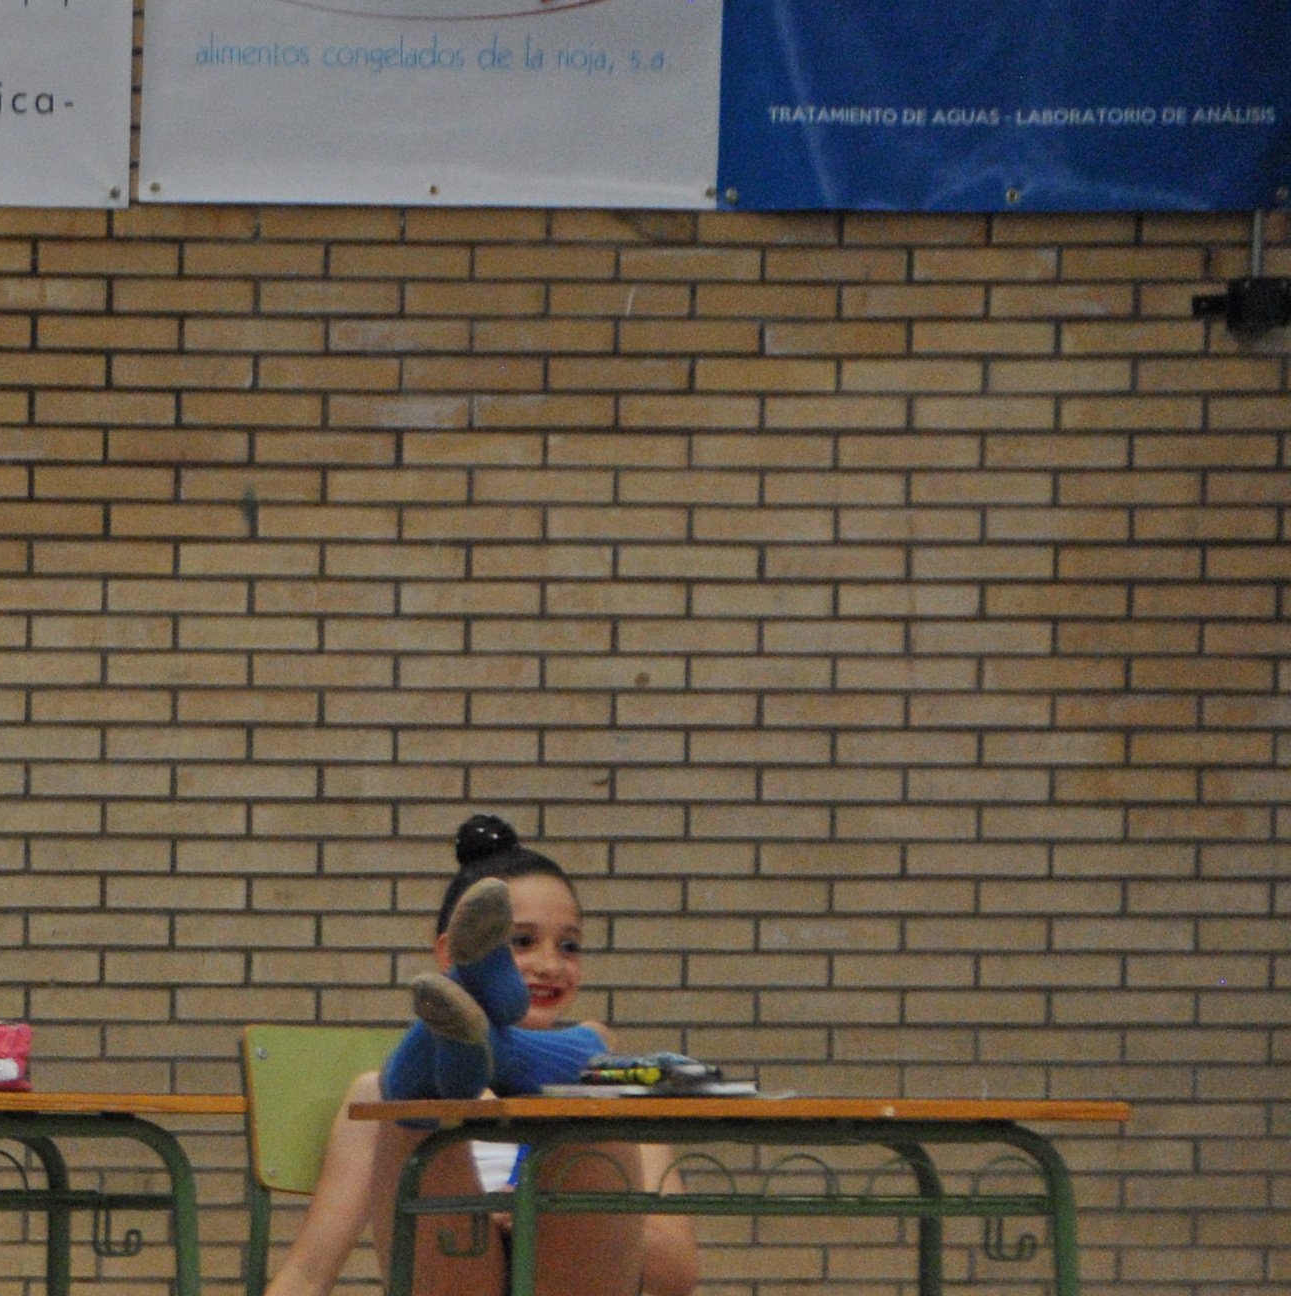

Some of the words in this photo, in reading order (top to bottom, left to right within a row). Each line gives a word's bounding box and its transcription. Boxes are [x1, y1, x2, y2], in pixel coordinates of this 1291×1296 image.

[196, 31, 310, 67] alimentos
[322, 32, 466, 73] congelados
[478, 32, 513, 70] de
[525, 33, 544, 70] la
[769, 105, 898, 126] TRATAMIENTO
[902, 107, 928, 126] DE
[932, 108, 1000, 126] AGUAS
[1016, 106, 1157, 126] LABORATORIO
[1162, 106, 1188, 125] DE
[1192, 102, 1276, 124] ANÁLISIS
